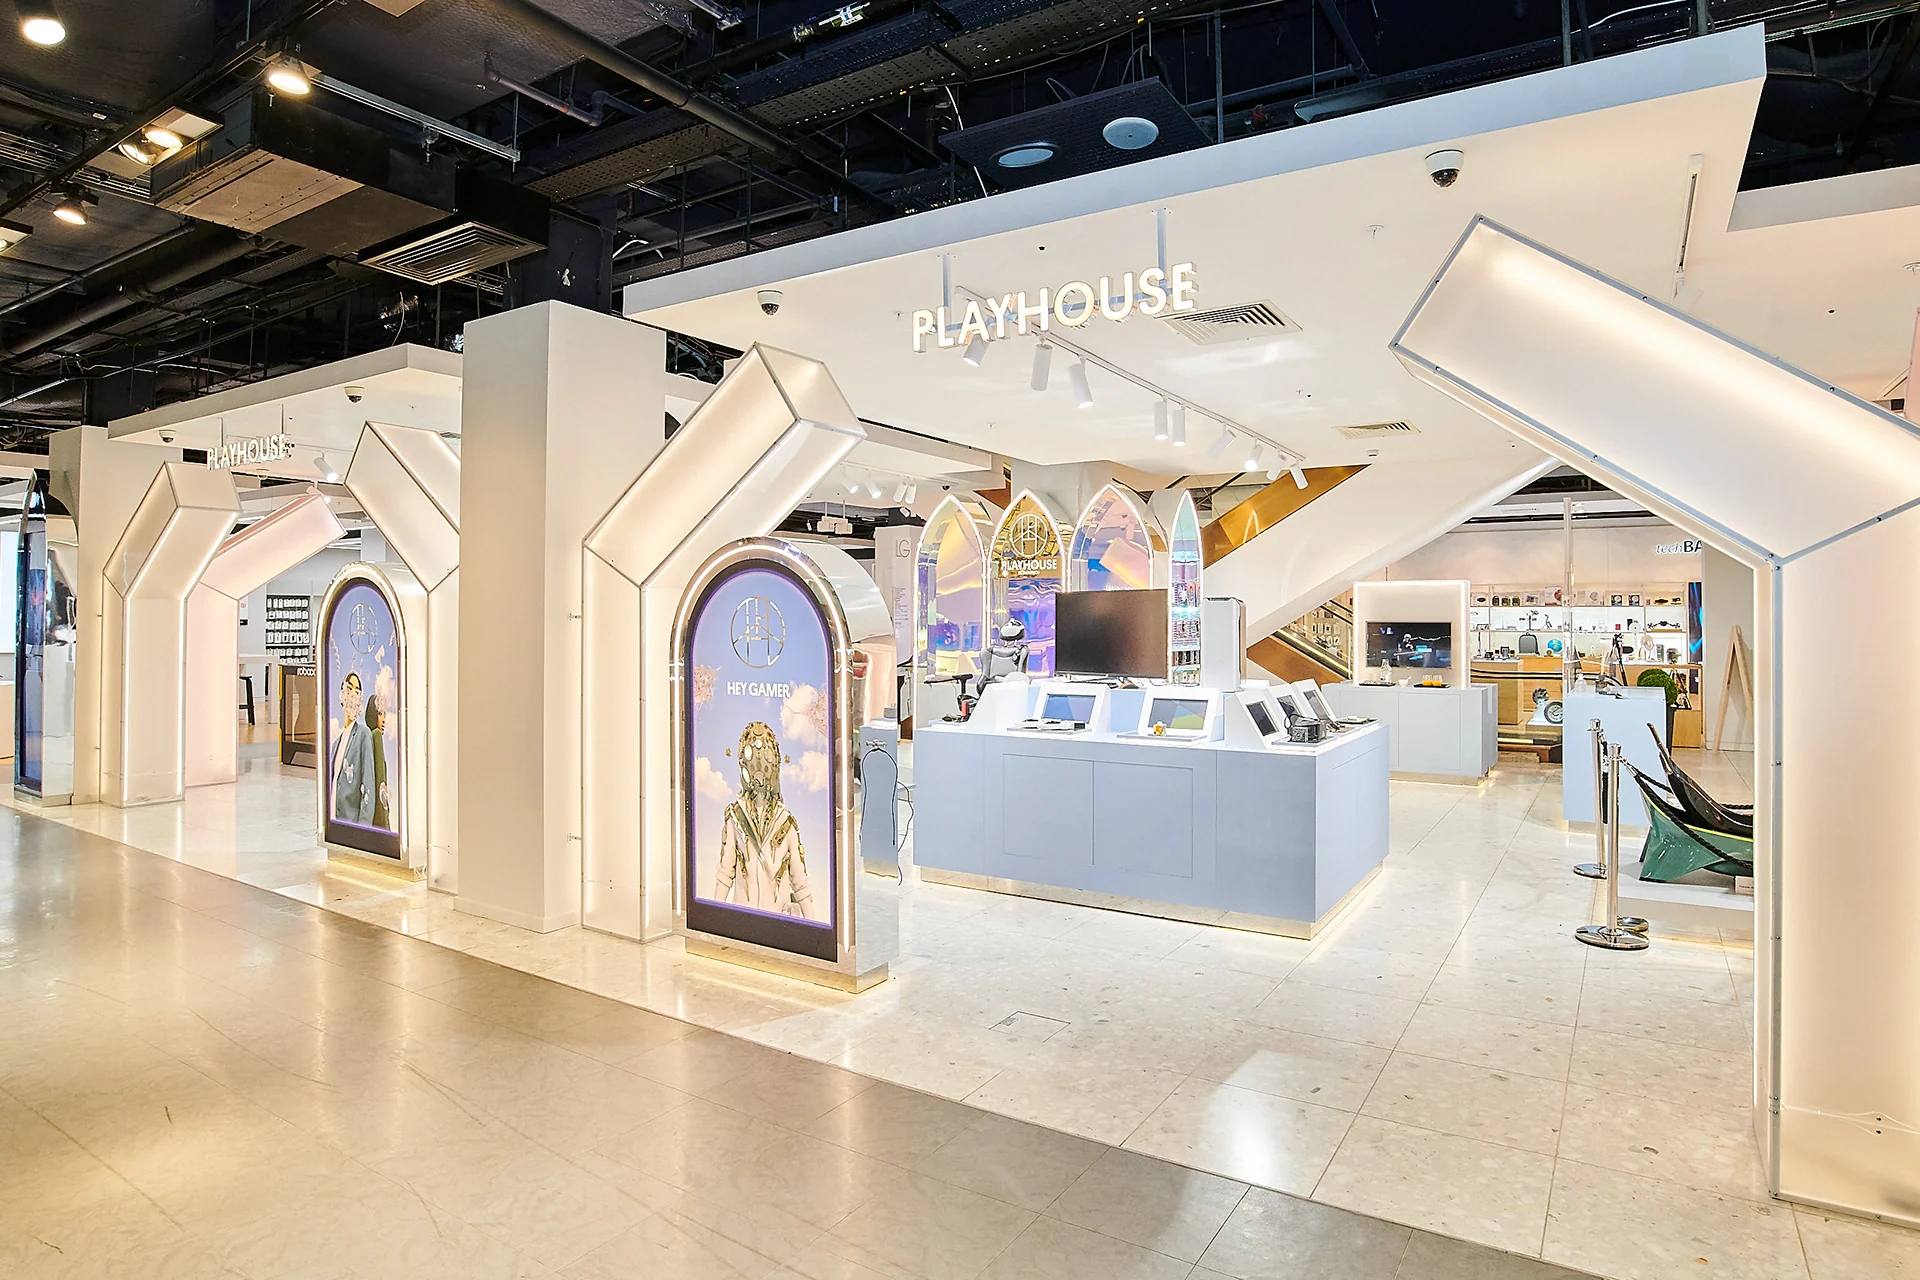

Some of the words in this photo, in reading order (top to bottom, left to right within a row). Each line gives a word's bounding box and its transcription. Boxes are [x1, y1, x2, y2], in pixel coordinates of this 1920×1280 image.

[912, 261, 1198, 353] PLAYHOUSE
[206, 433, 287, 471] PLAYHOUSE
[895, 539, 911, 558] LG
[1000, 558, 1058, 571] PLAYHOUSE
[727, 681, 747, 696] HEY
[748, 682, 791, 699] GAMER
